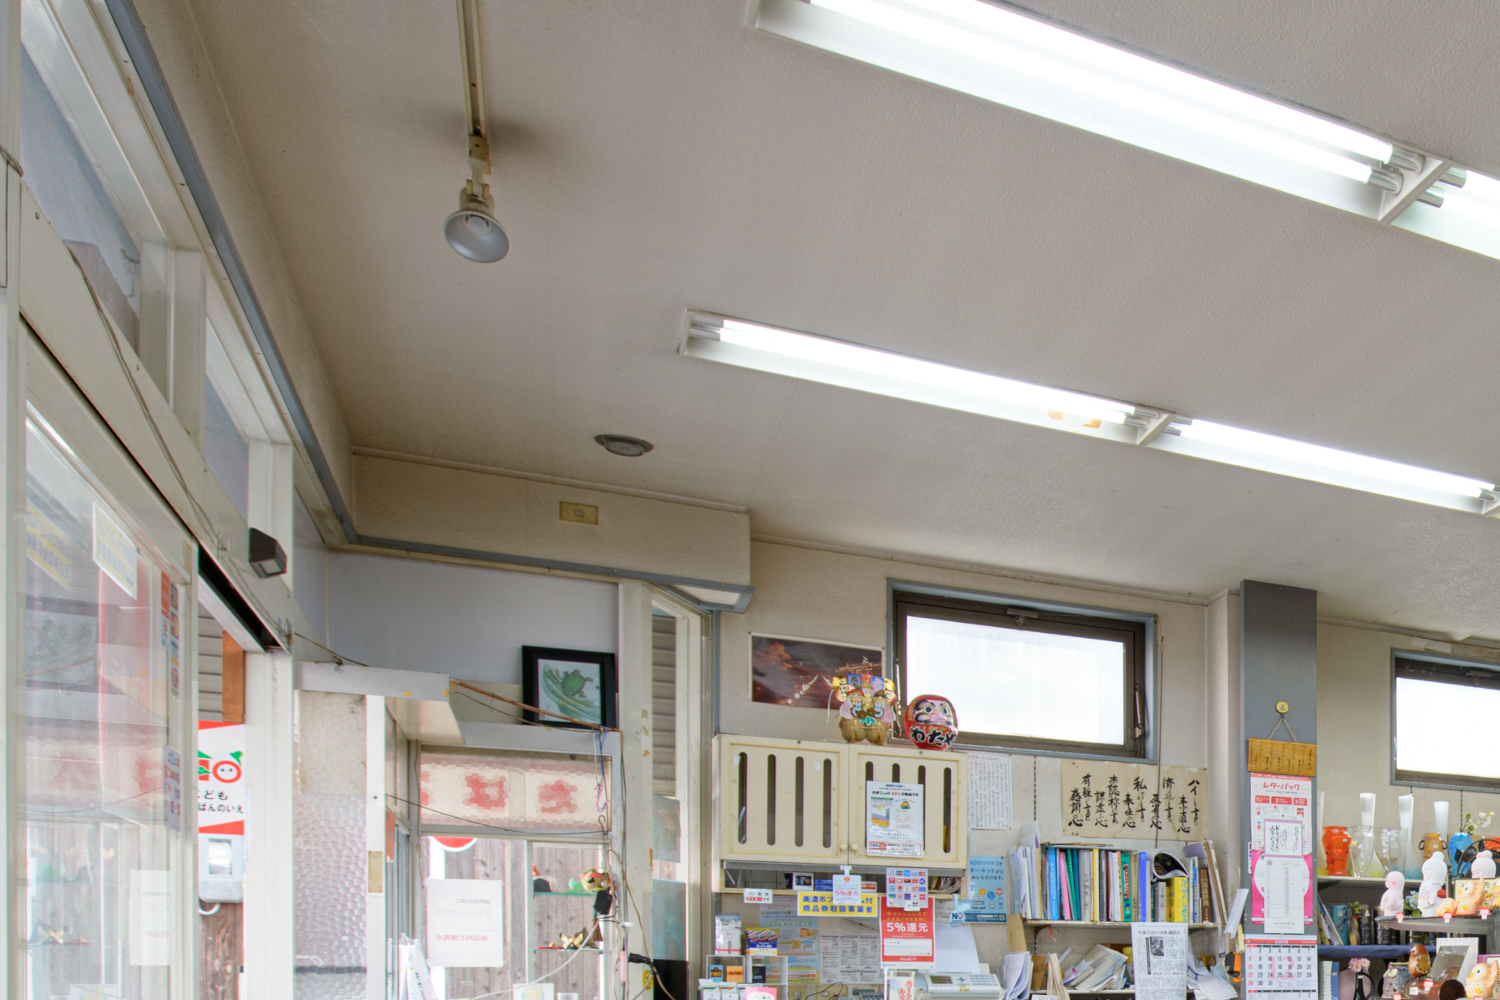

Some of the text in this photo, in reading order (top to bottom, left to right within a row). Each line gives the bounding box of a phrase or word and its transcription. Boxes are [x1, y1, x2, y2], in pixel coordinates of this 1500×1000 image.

[1263, 782, 1301, 791] レターパック
[802, 895, 873, 904] 美濃市プ付
[802, 904, 873, 913] 商品券取扱事業者
[886, 922, 929, 933] 5%還元
